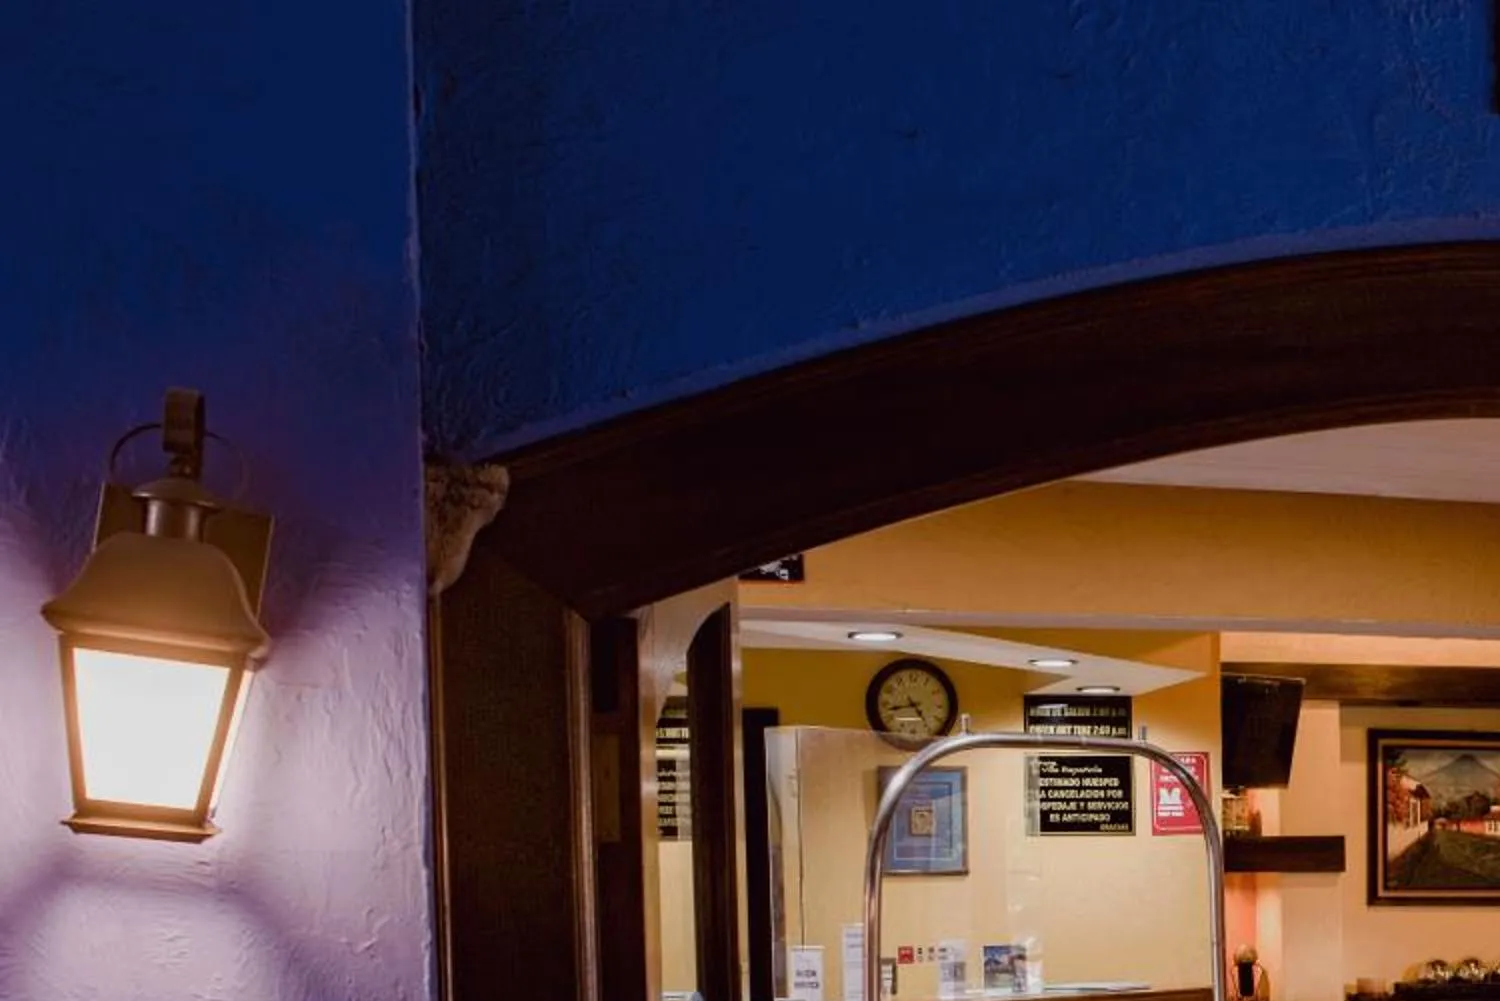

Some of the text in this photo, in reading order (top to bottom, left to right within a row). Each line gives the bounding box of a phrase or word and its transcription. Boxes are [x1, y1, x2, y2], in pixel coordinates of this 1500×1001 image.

[1106, 789, 1124, 799] POR
[1087, 801, 1129, 811] SERVICIOS
[1049, 813, 1111, 823] ES ANTICIPADO
